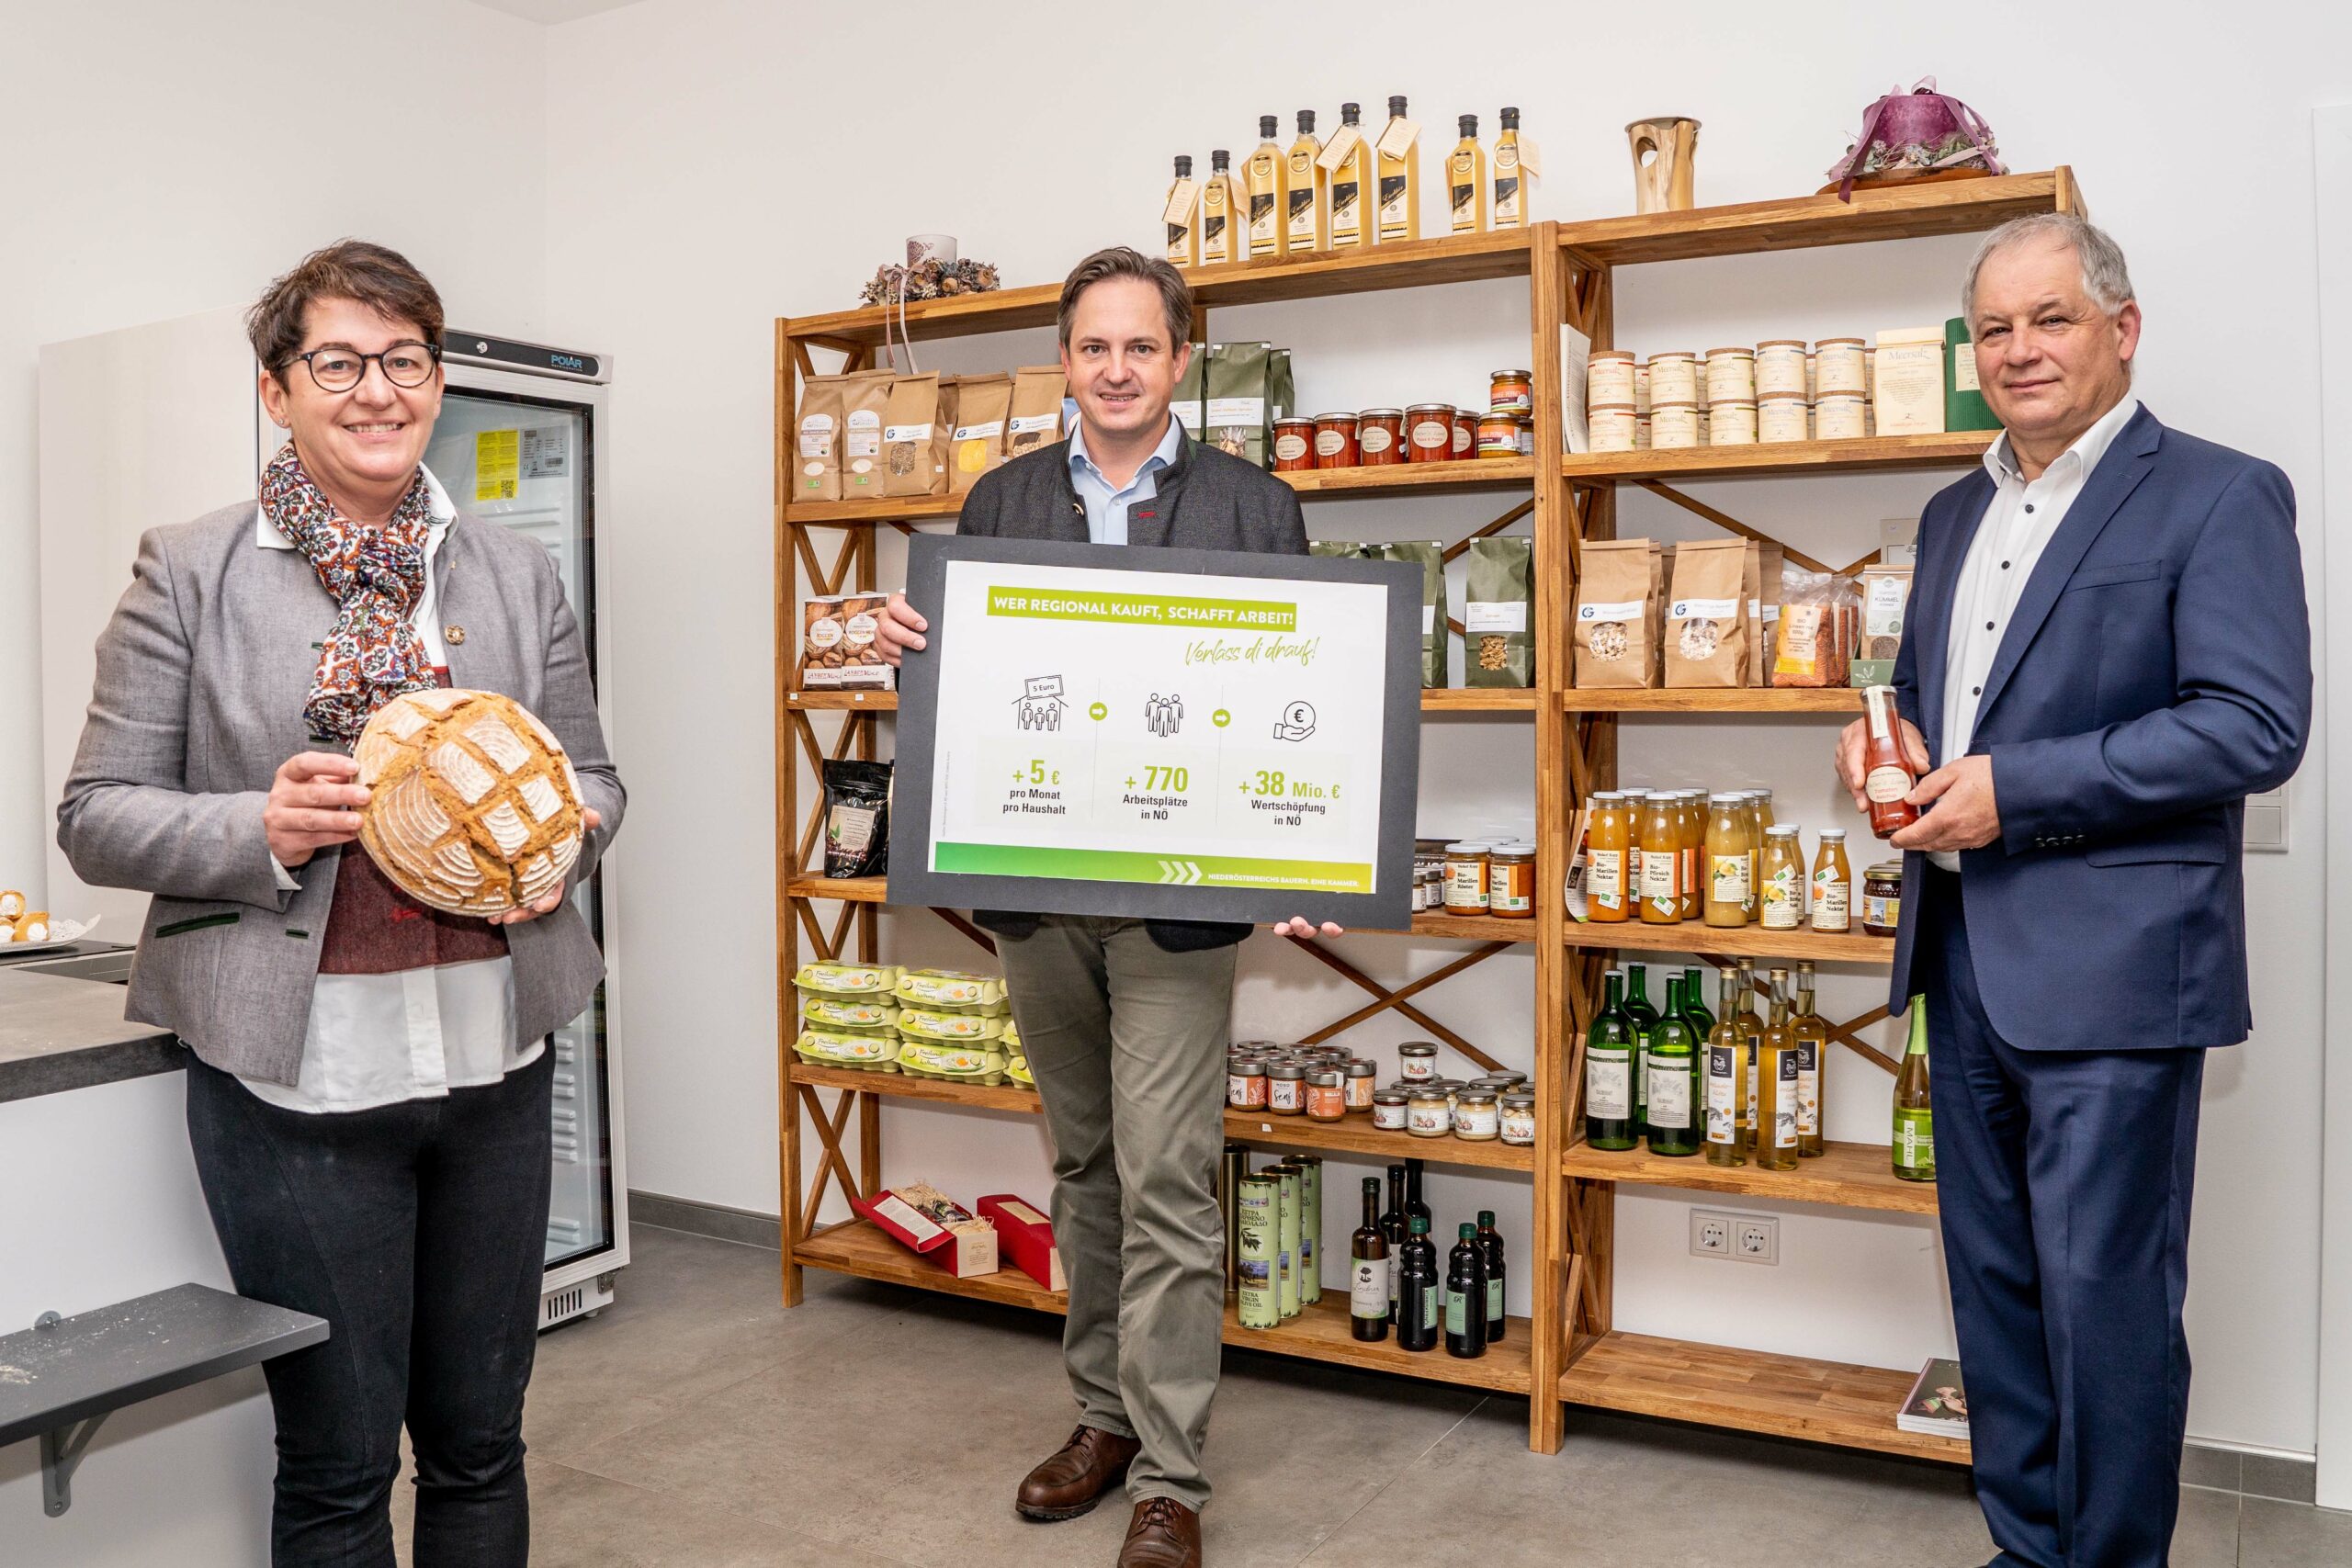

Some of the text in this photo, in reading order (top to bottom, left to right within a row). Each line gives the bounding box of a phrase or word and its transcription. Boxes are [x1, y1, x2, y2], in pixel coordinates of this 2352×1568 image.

[1888, 348, 1930, 360] Meersalz
[551, 355, 582, 368] POLAR
[994, 595, 1294, 626] WER REGIONAL KAUFT, SCHAFFT ARBEIT!
[1185, 636, 1320, 666] Verlass di drauf!
[1294, 709, 1304, 723] €
[1012, 759, 1060, 784] + 5 €
[1125, 765, 1189, 793] + 770
[1238, 771, 1340, 799] + 38 Mio. €
[1010, 788, 1060, 800] pro Monat
[1123, 794, 1188, 808] Arbeitsplätze
[1002, 803, 1066, 816] pro Haushalt
[1140, 807, 1169, 820] in NÖ
[1250, 798, 1327, 815] Wertschöpfung
[1273, 813, 1302, 827] in NÖ
[1208, 873, 1280, 884] NIEDERÖSTERREICHS
[1328, 879, 1359, 887] KAMMER.
[1274, 1089, 1292, 1105] Senf
